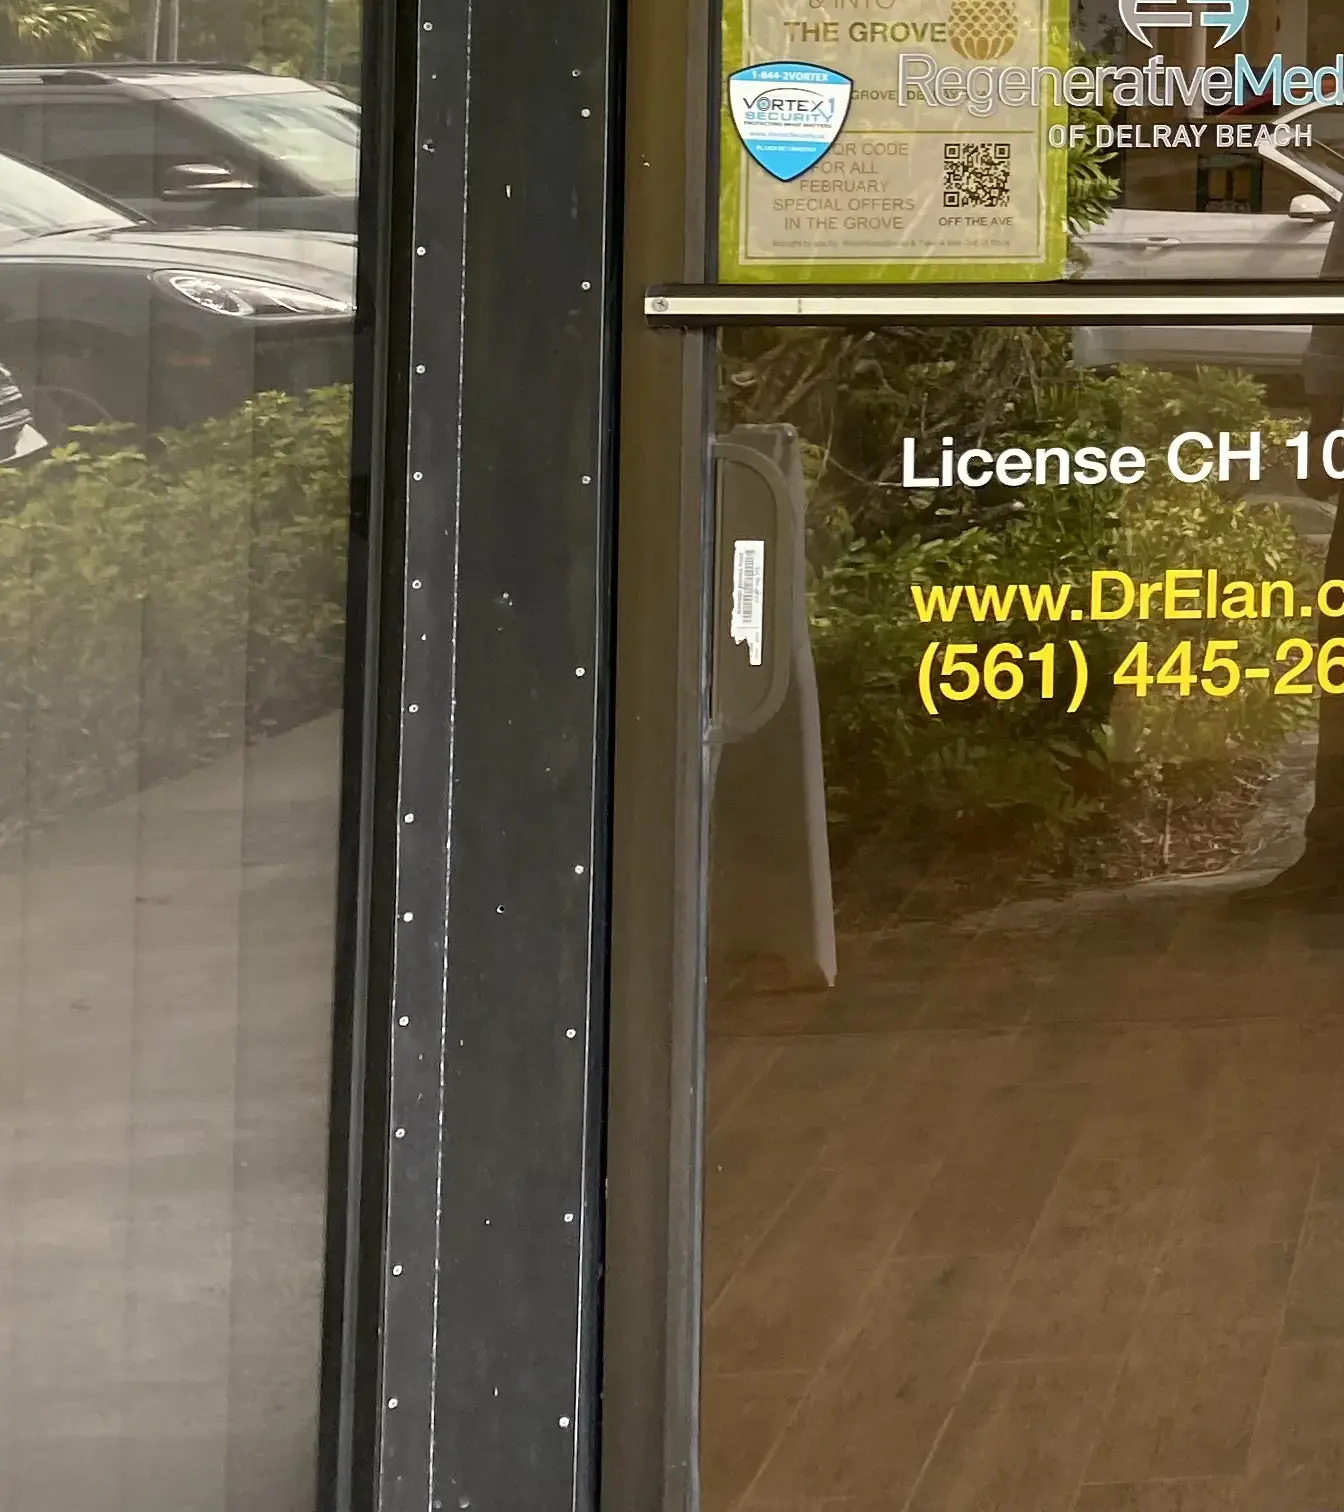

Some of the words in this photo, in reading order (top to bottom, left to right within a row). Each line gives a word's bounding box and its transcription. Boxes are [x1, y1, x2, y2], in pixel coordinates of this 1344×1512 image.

[784, 22, 838, 42] THE
[848, 22, 948, 42] GROVE
[745, 112, 832, 122] SECURITY
[1049, 124, 1084, 148] OF
[1097, 124, 1207, 148] DELRAY
[1218, 124, 1312, 148] BEACH
[834, 143, 857, 157] QR
[862, 143, 909, 156] CODE
[851, 161, 878, 174] ALL
[799, 180, 890, 193] FEBRUARY
[772, 198, 841, 211] SPECIAL
[848, 198, 915, 211] OFFERS
[784, 217, 801, 230] IN
[806, 217, 838, 230] THE
[844, 217, 904, 230] GROVE
[939, 217, 962, 226] OFF
[966, 217, 987, 226] THE
[990, 217, 1013, 226] AVE
[903, 436, 1145, 488] License
[1167, 431, 1260, 483] CH
[918, 639, 1088, 716] (561)
